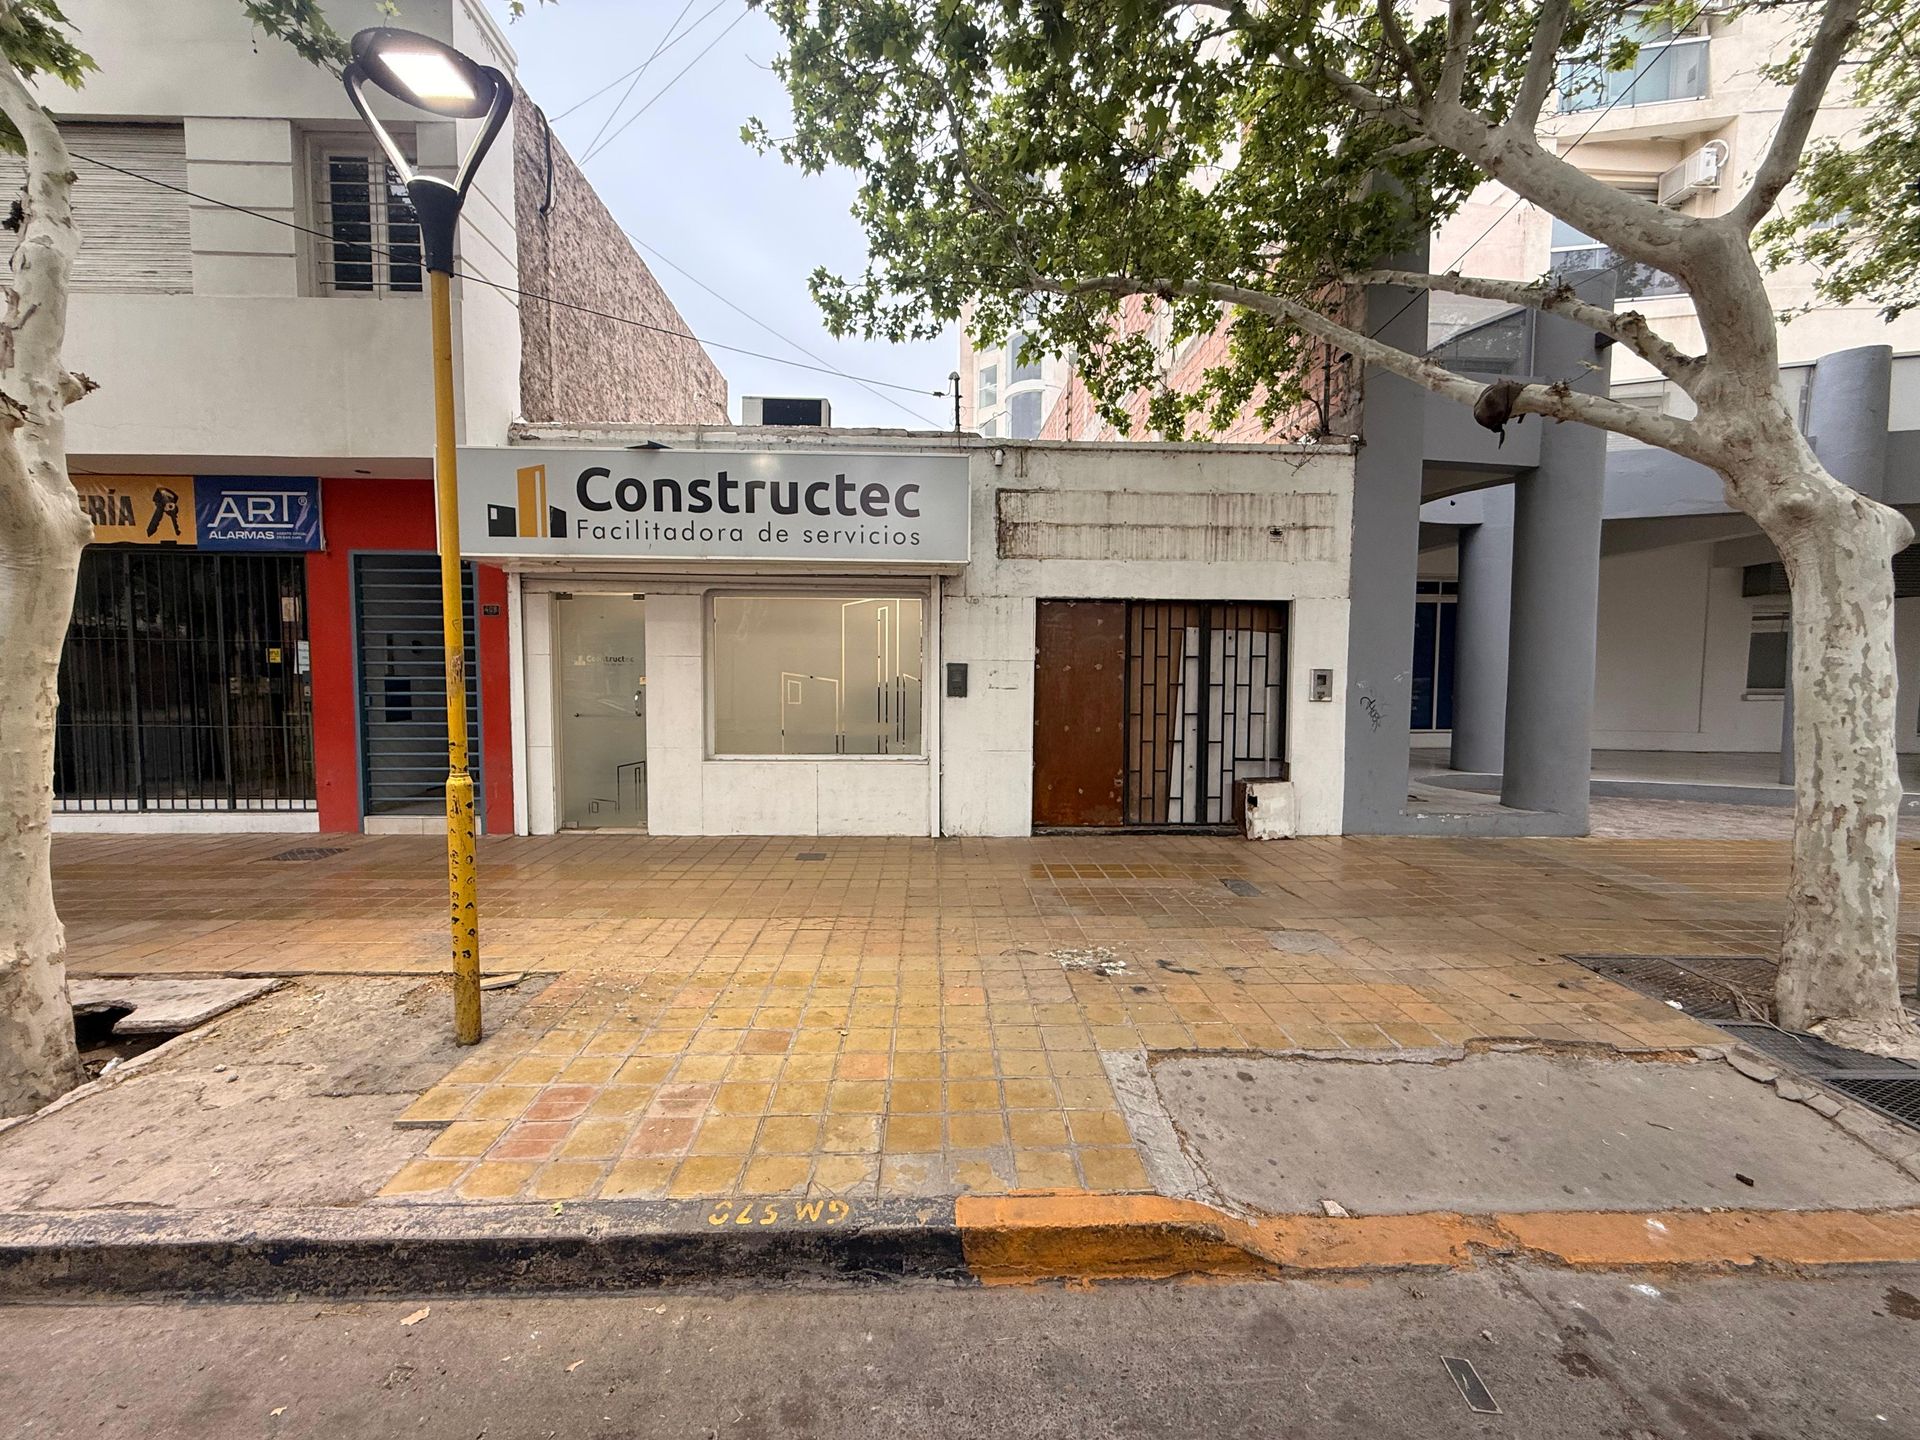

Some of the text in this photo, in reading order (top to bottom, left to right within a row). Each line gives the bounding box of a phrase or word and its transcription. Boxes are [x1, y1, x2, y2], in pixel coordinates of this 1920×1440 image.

[577, 467, 920, 517] Constructec
[207, 490, 308, 528] ART
[208, 530, 275, 540] ALARMAS
[577, 518, 920, 546] Facilitadora de servicios
[707, 1199, 850, 1225] GM 570
